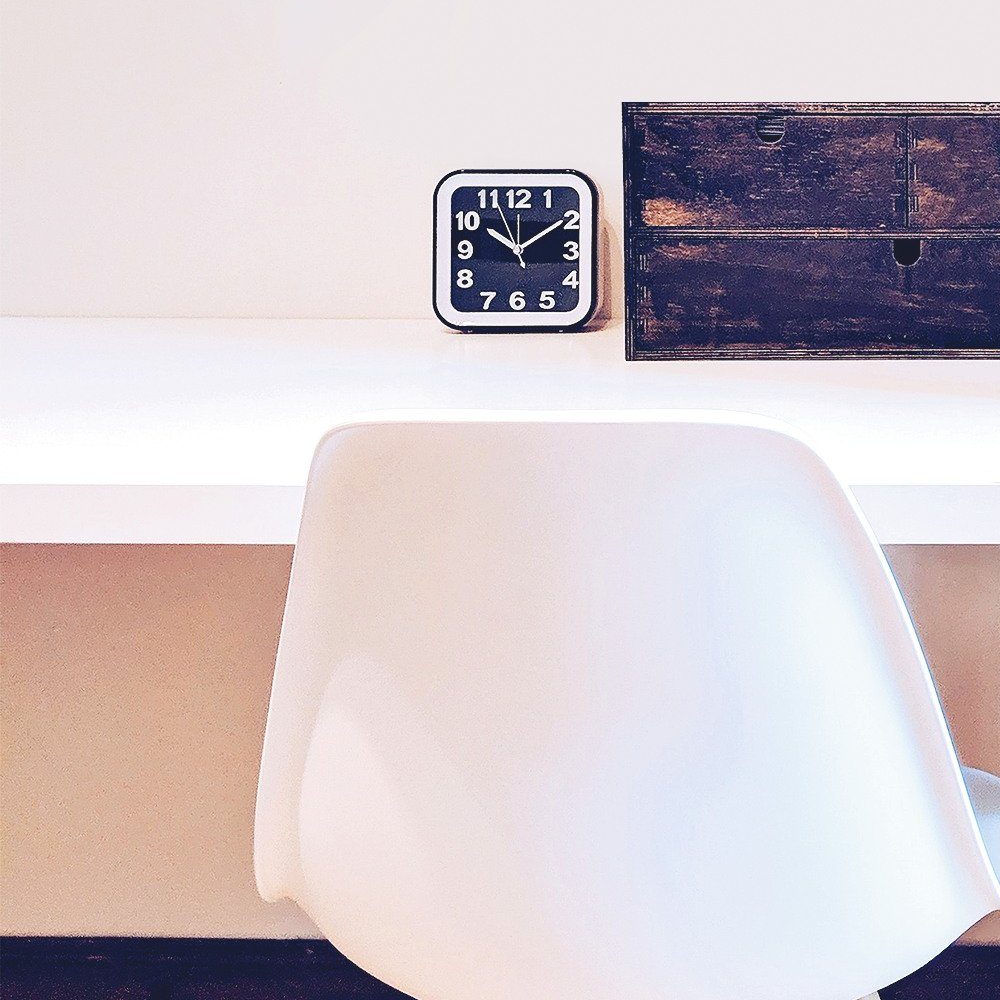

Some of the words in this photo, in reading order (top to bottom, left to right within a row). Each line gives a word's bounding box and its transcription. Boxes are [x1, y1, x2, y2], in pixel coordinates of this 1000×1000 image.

[477, 189, 498, 209] 11
[506, 189, 532, 209] 12
[543, 189, 552, 209] 1
[455, 211, 480, 231] 10
[563, 210, 580, 230] 2
[457, 239, 474, 260] 9
[562, 241, 580, 261] 3
[456, 269, 474, 289] 8
[562, 270, 580, 289] 4
[479, 291, 497, 310] 7
[509, 291, 526, 310] 6
[539, 290, 556, 310] 5
